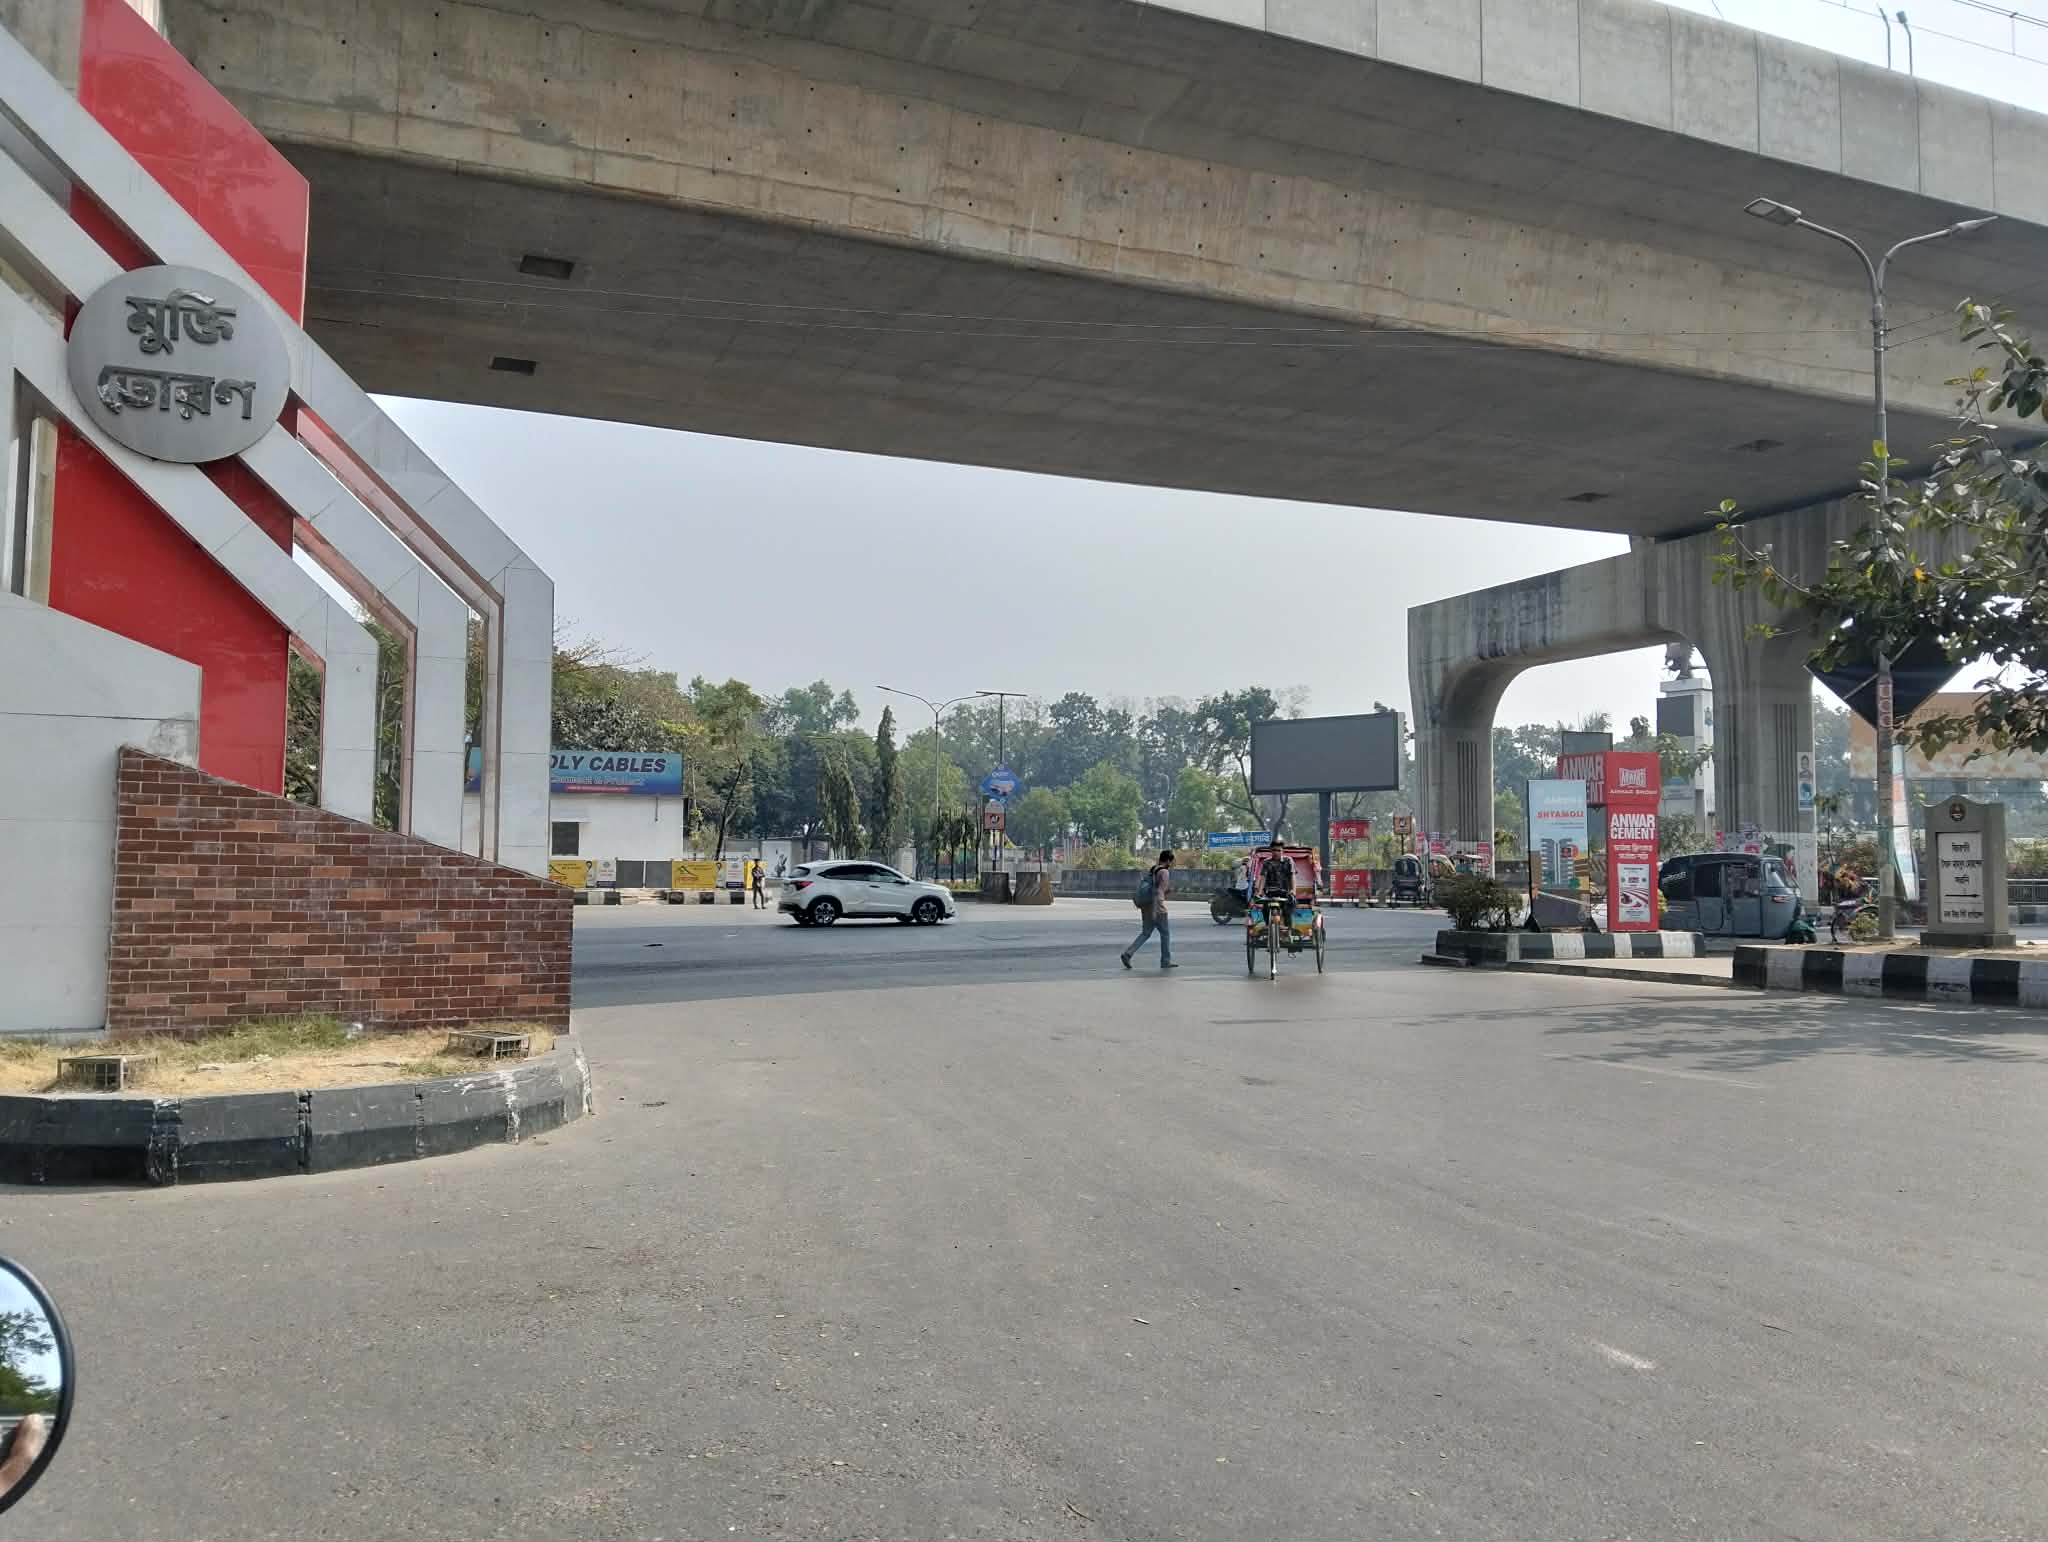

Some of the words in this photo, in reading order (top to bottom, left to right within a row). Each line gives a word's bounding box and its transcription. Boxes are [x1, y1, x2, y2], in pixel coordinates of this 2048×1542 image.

[126, 288, 237, 354] মুক্তি
[98, 365, 256, 419] তোরণ
[589, 756, 667, 773] CABLES
[1562, 756, 1604, 780] ANWAR
[1611, 813, 1656, 828] ANWAR
[1610, 827, 1655, 840] CEMENT
